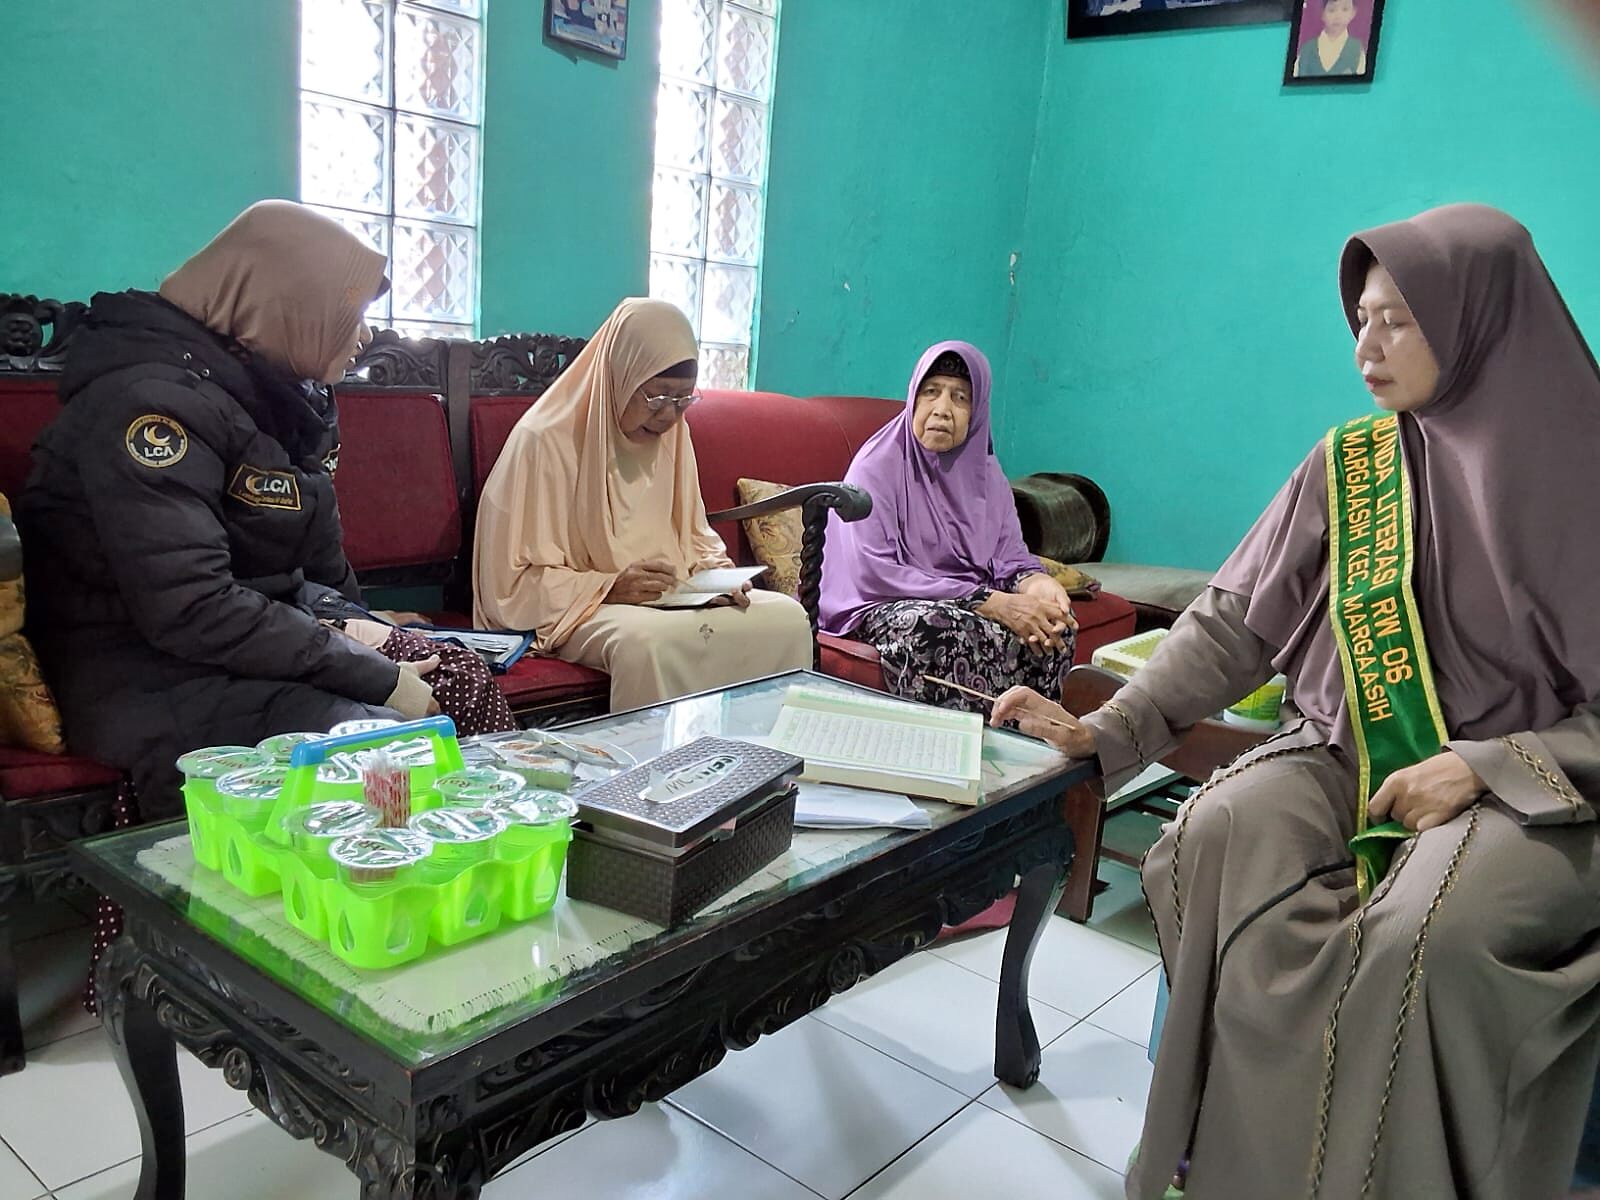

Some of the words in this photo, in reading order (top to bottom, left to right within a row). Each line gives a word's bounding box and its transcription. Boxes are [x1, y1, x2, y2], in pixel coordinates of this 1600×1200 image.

[144, 446, 175, 458] LCA
[1372, 416, 1398, 486] BUNDA
[262, 479, 293, 496] LCA
[1342, 428, 1370, 542] MARGAASIH
[1370, 488, 1399, 591] LITERASI
[1371, 595, 1402, 638] RW
[1342, 594, 1393, 722] MARGAASIH
[1382, 647, 1414, 684] 06
